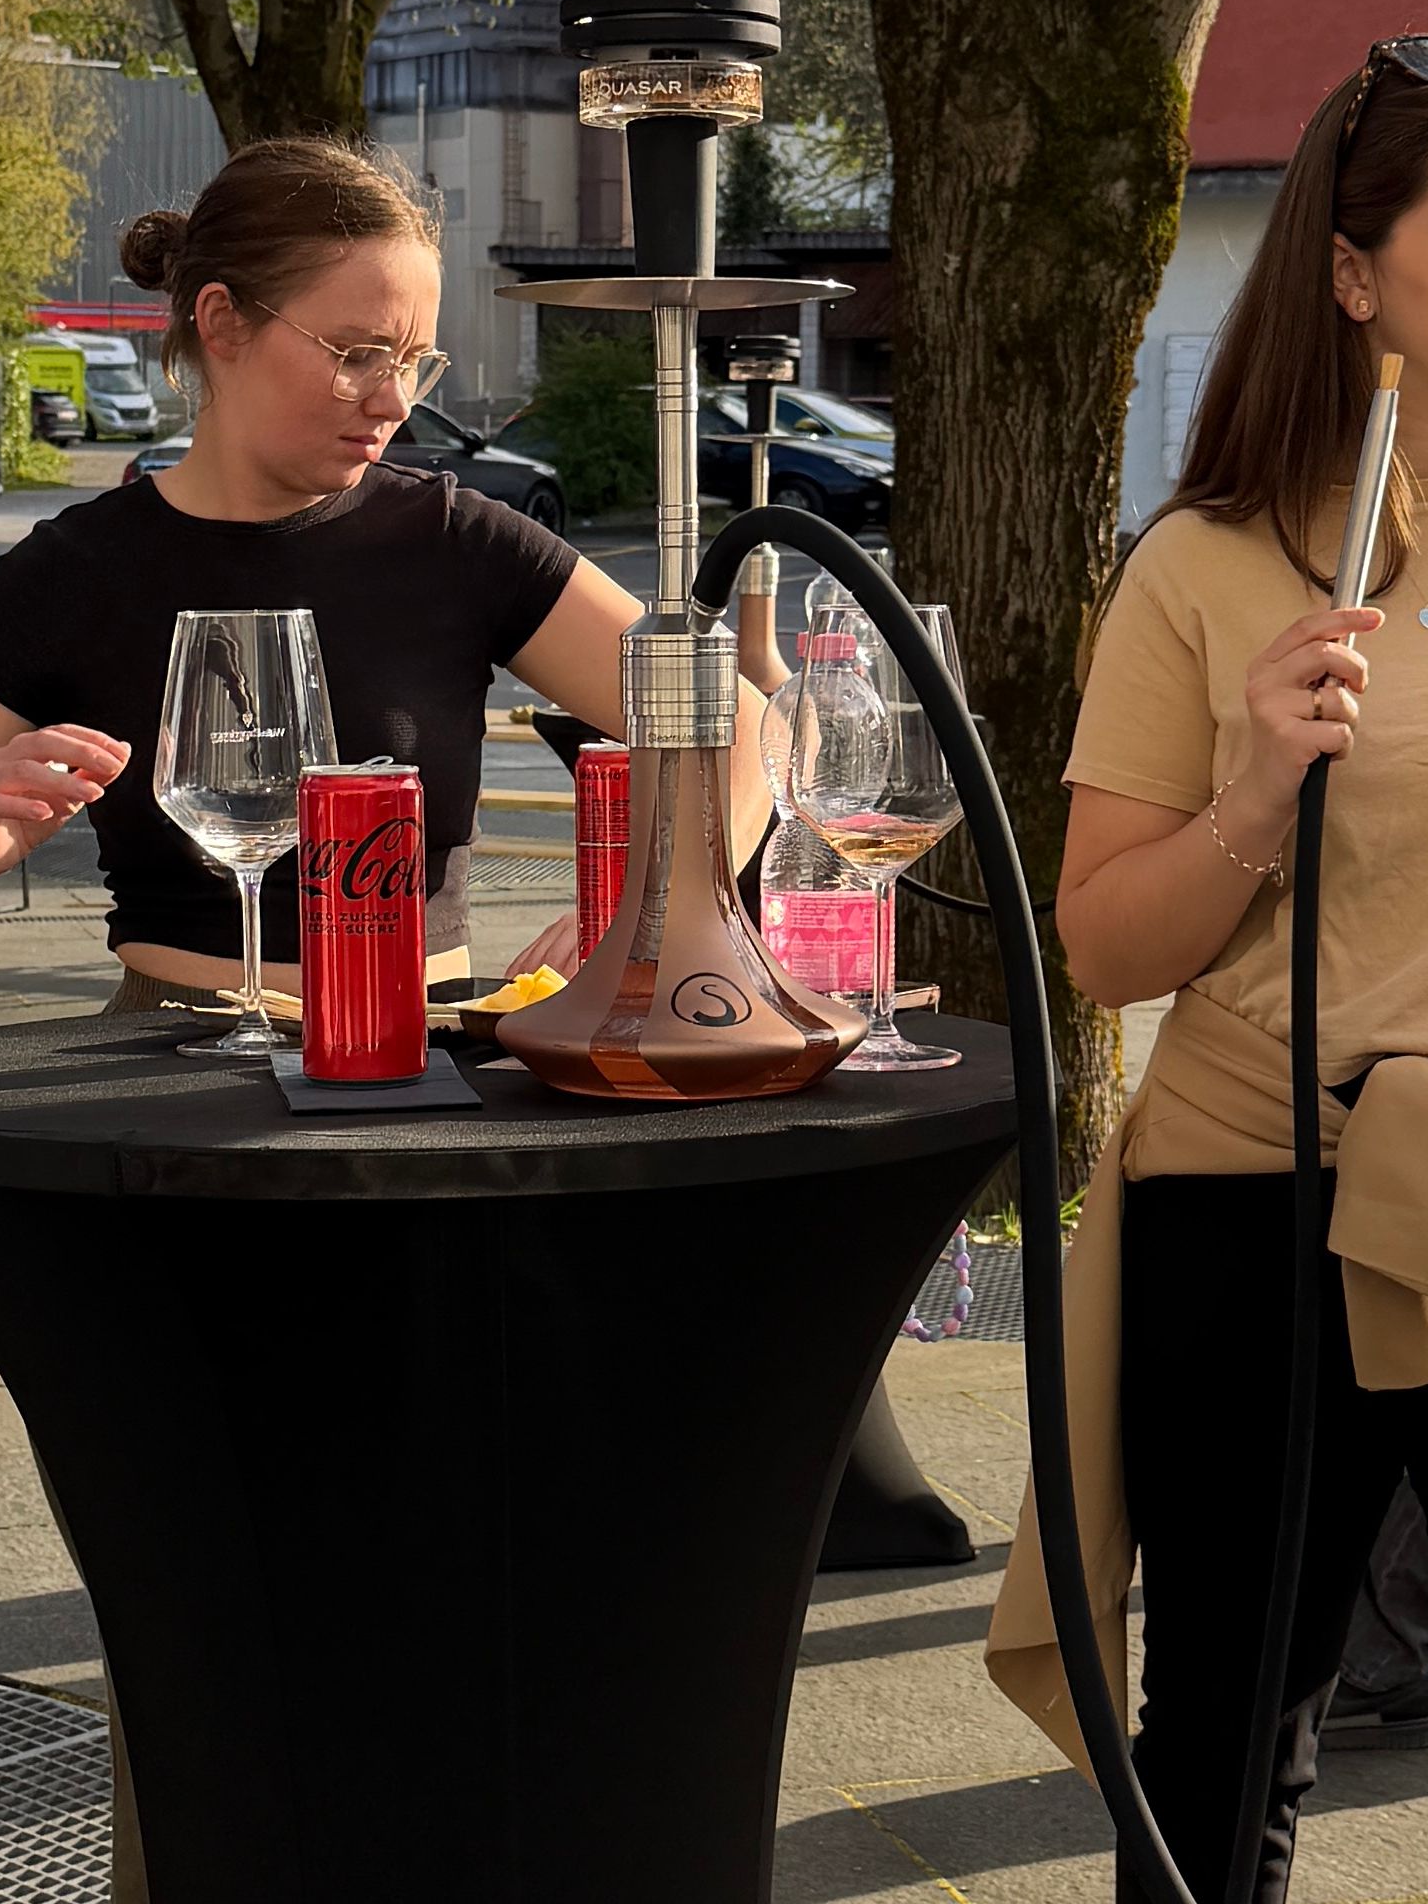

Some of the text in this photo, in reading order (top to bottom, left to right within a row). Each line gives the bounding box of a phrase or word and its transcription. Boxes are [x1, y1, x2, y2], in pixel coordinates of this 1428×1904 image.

[600, 80, 682, 99] QUASAR
[339, 911, 401, 922] ZUCKER
[345, 923, 397, 934] SUCRE
